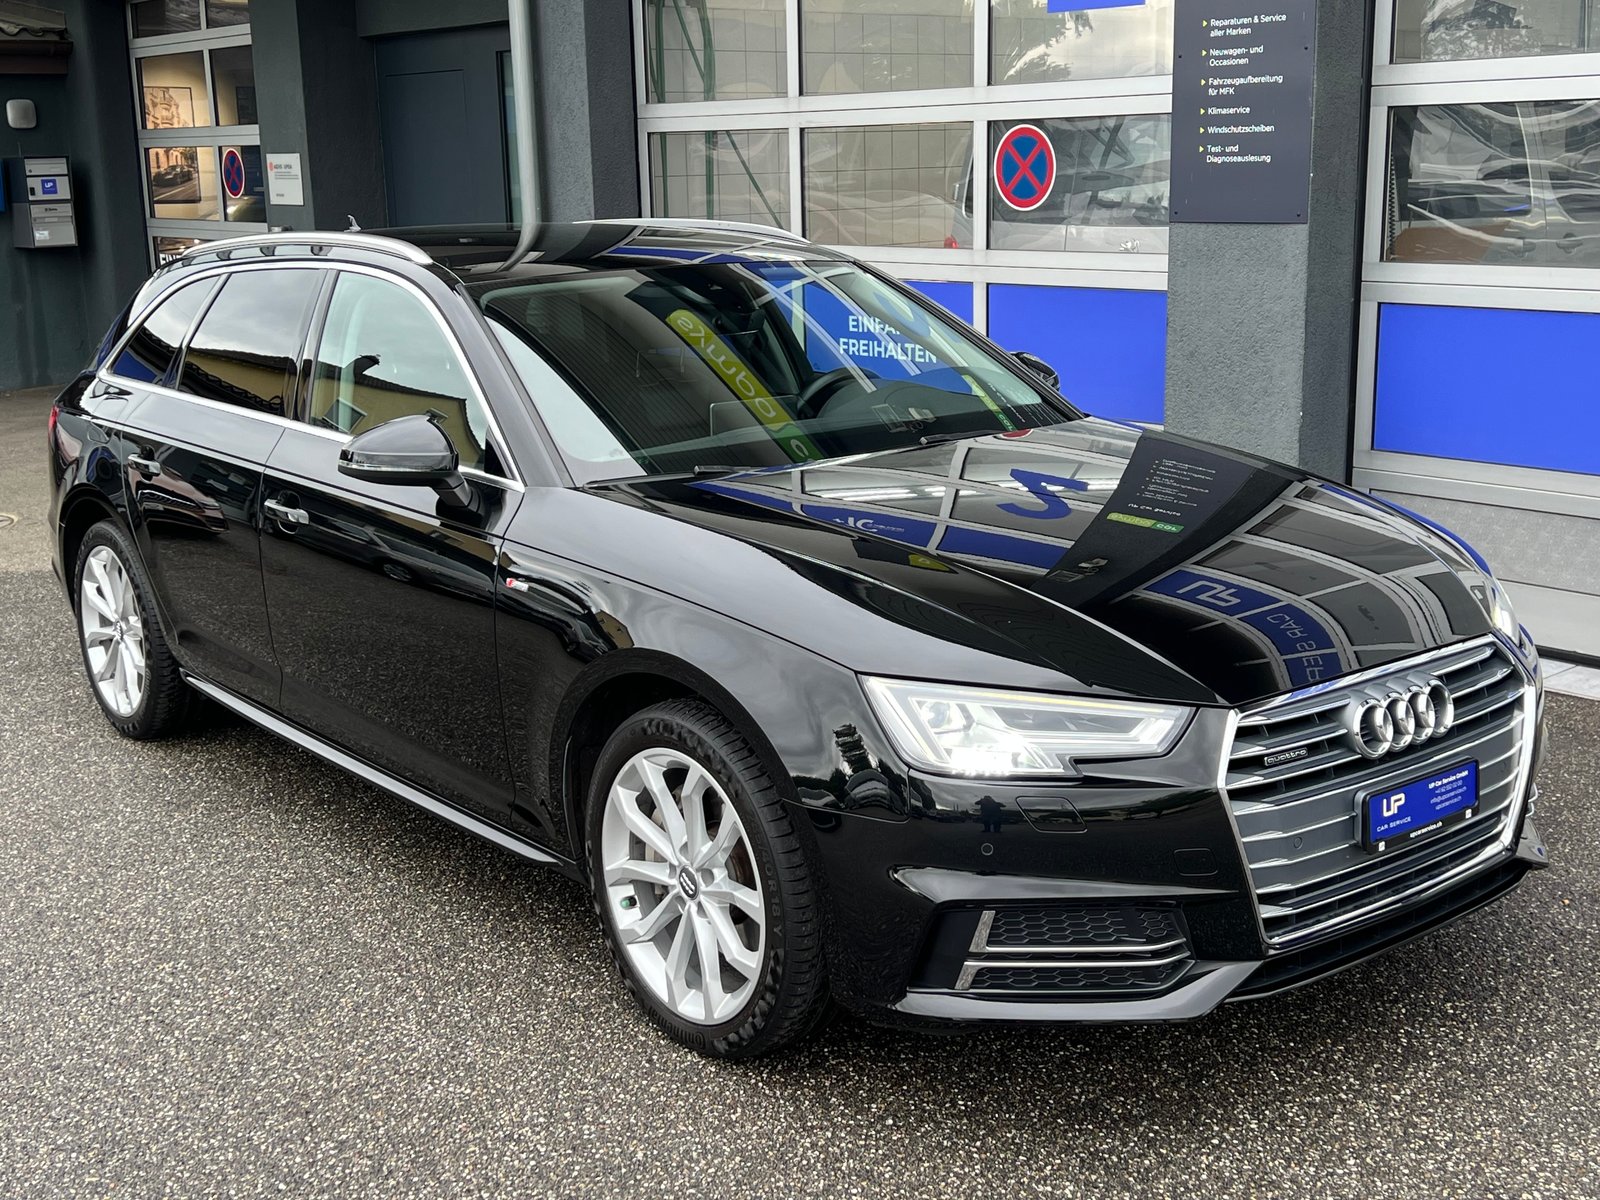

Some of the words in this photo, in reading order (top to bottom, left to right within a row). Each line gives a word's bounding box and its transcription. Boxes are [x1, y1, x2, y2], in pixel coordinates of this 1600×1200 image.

[1210, 16, 1252, 27] Reparaturen
[1253, 15, 1259, 23] &
[1260, 13, 1287, 23] Service
[1210, 29, 1224, 37] aller
[1226, 27, 1251, 36] Marken
[1209, 47, 1248, 57] Neuwagen-
[1250, 45, 1264, 54] und
[1209, 57, 1249, 67] Occasionen
[1208, 74, 1284, 86] Fahrzeugaufbereitung
[1208, 87, 1218, 96] für
[1219, 87, 1235, 95] MFK
[1208, 106, 1251, 115] Klimaservice
[1207, 124, 1275, 134] Windschutzscheiben
[1207, 145, 1224, 153] Test-
[1225, 144, 1239, 152] und
[1206, 154, 1272, 163] Diagnoseauslesung
[839, 337, 938, 364] FREIHALTEN
[1267, 749, 1307, 764] quattro
[1382, 792, 1406, 817] UP
[1376, 823, 1389, 832] CAR
[1389, 816, 1412, 827] SERVICE
